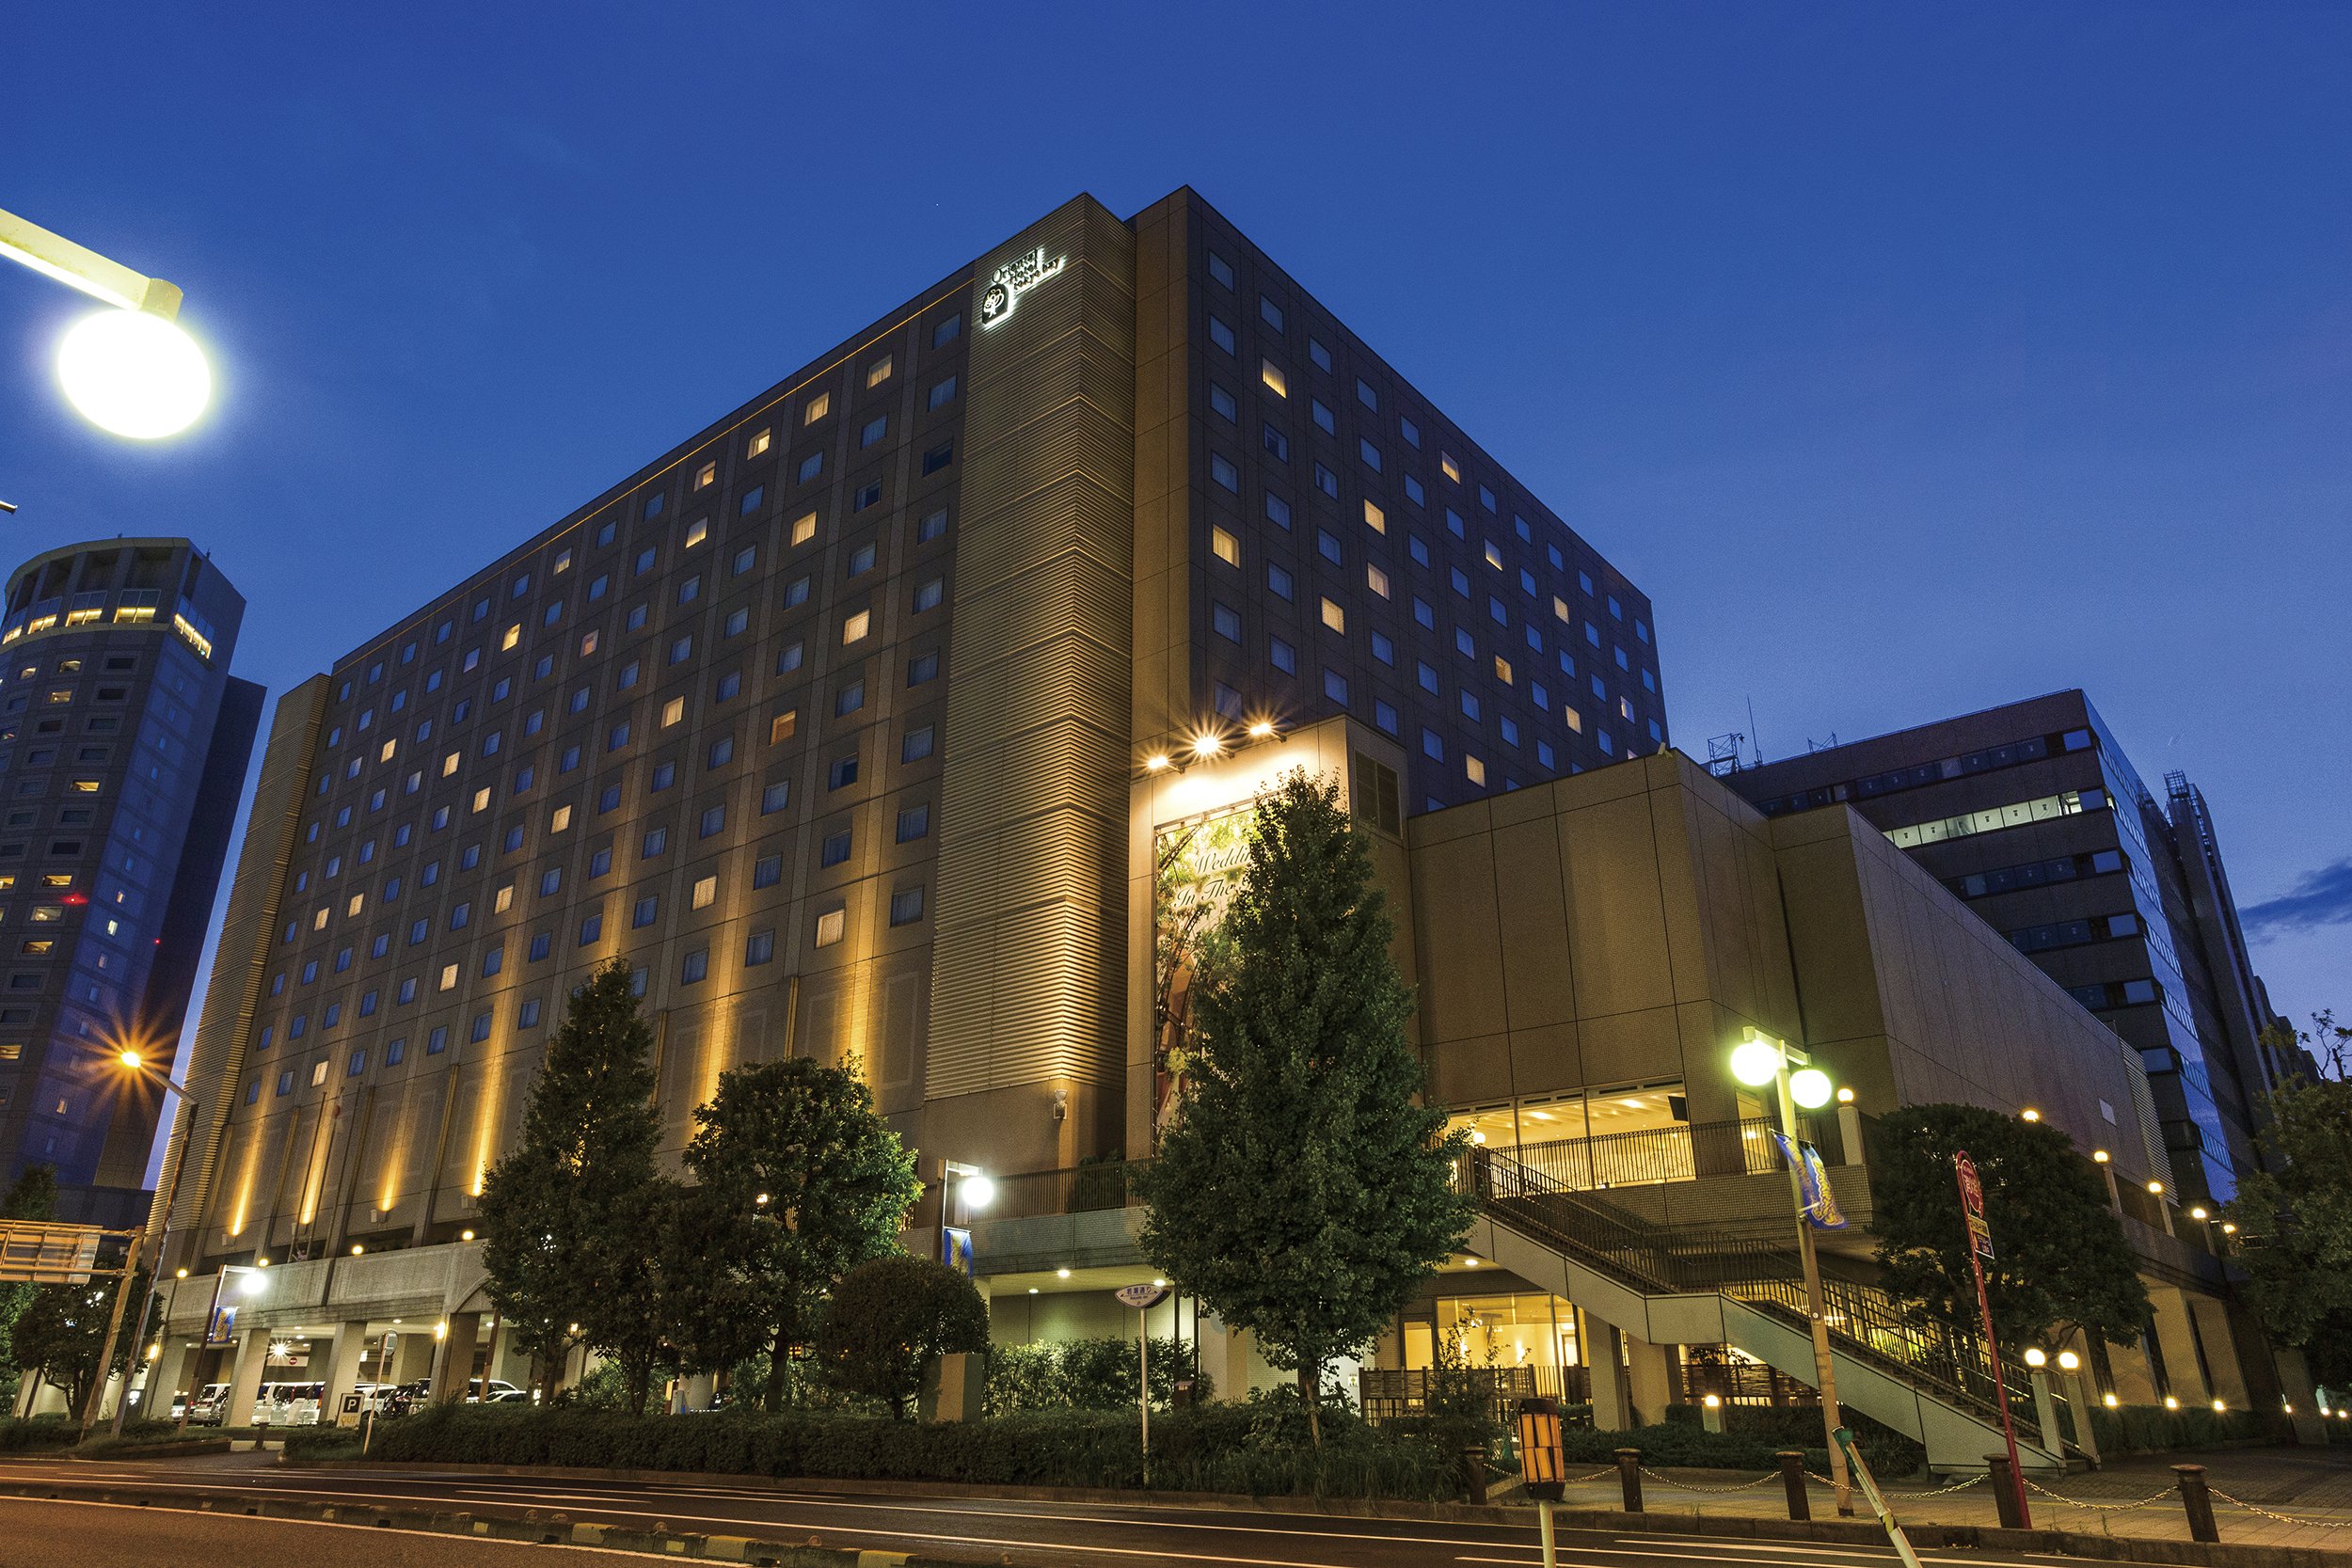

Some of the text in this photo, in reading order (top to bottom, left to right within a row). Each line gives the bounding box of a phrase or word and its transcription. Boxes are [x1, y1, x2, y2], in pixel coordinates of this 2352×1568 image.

[1174, 885, 1196, 908] In
[1201, 879, 1234, 901] The
[347, 1399, 357, 1411] P
